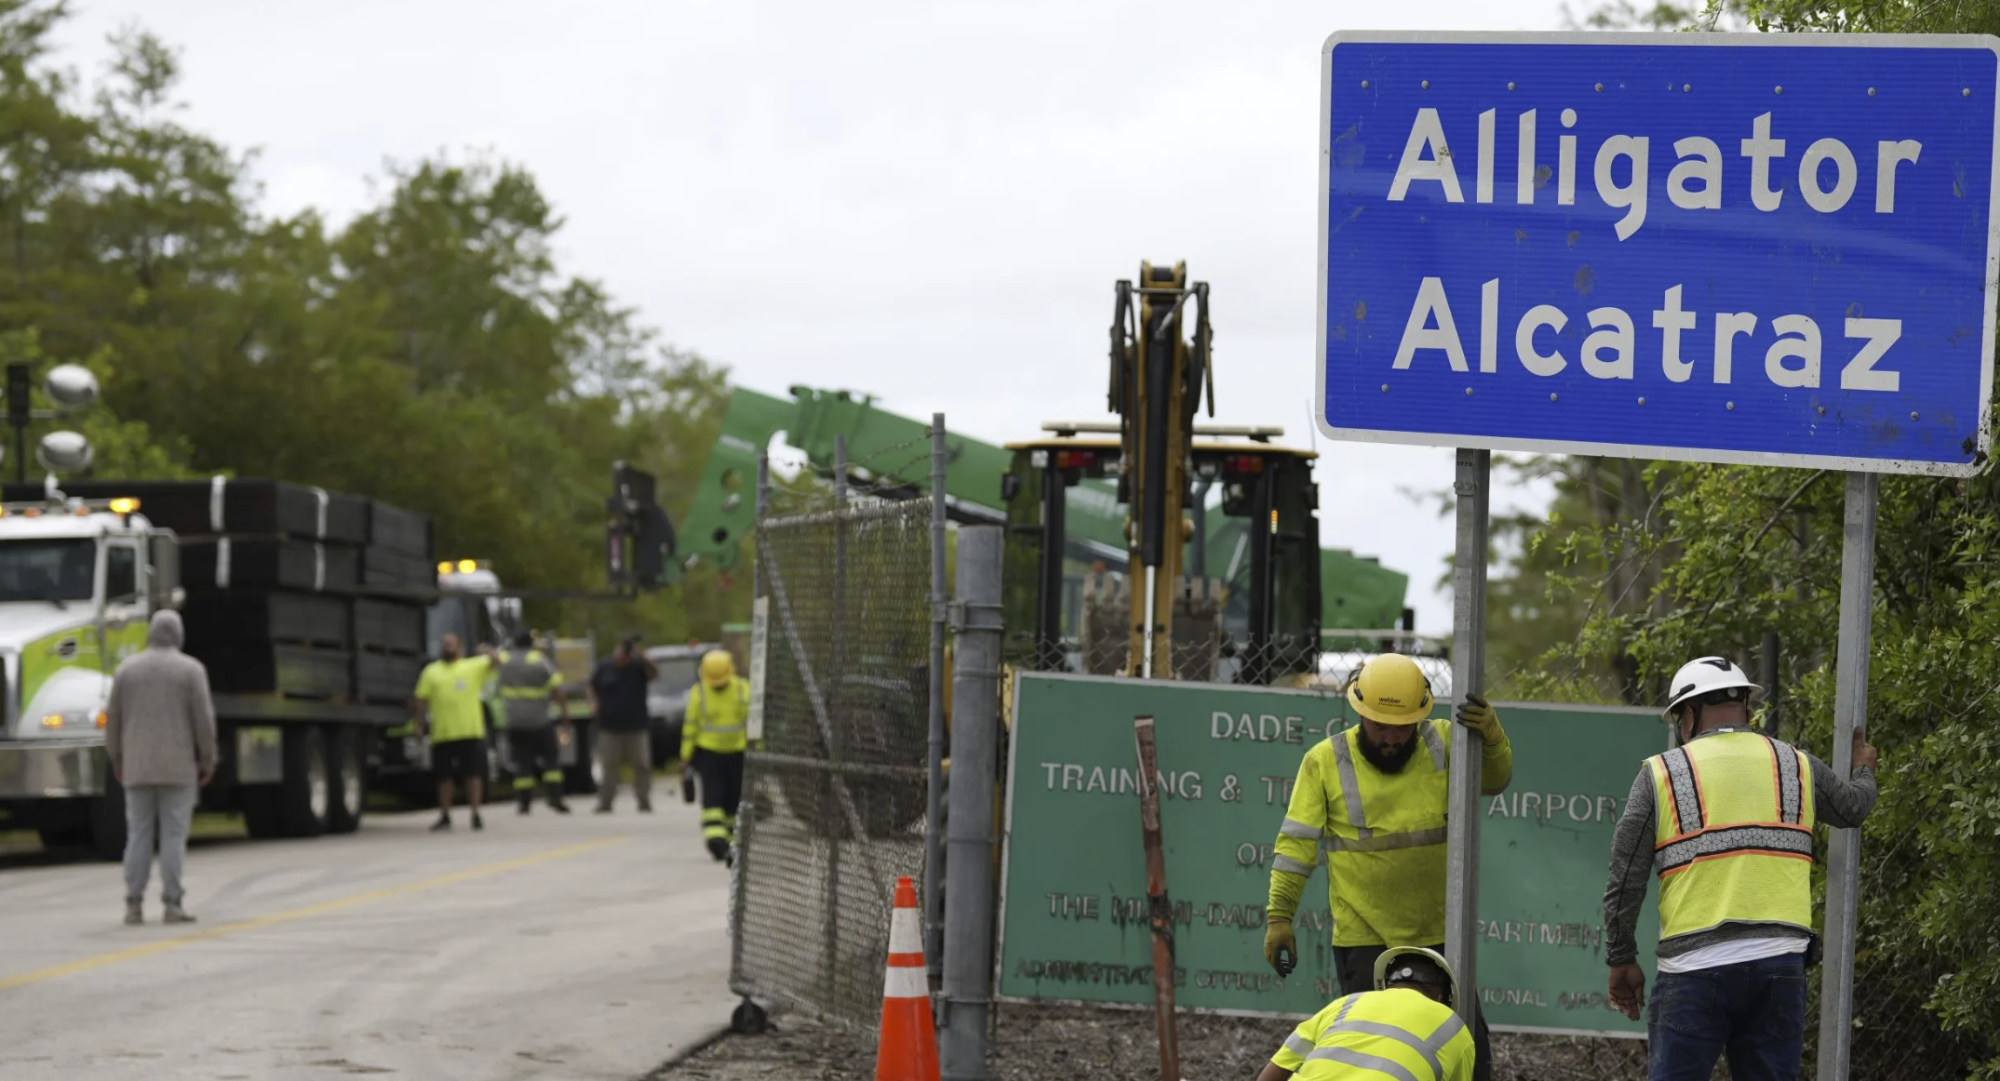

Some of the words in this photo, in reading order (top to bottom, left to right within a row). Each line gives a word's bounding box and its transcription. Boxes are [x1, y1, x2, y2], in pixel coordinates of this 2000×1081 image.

[1387, 107, 1922, 241] Alligator
[1392, 276, 1902, 392] Alcatraz
[1378, 696, 1401, 704] webber
[1210, 711, 1349, 743] DADE-C
[1041, 761, 1203, 801] TRAINNG
[1219, 774, 1241, 802] &
[1488, 791, 1630, 823] AIRPOR
[1046, 892, 1100, 920] THE
[1111, 895, 1266, 928] MIMI-DAD
[1014, 957, 1187, 988] ADMINISTRATE
[1194, 969, 1286, 992] OFFICES
